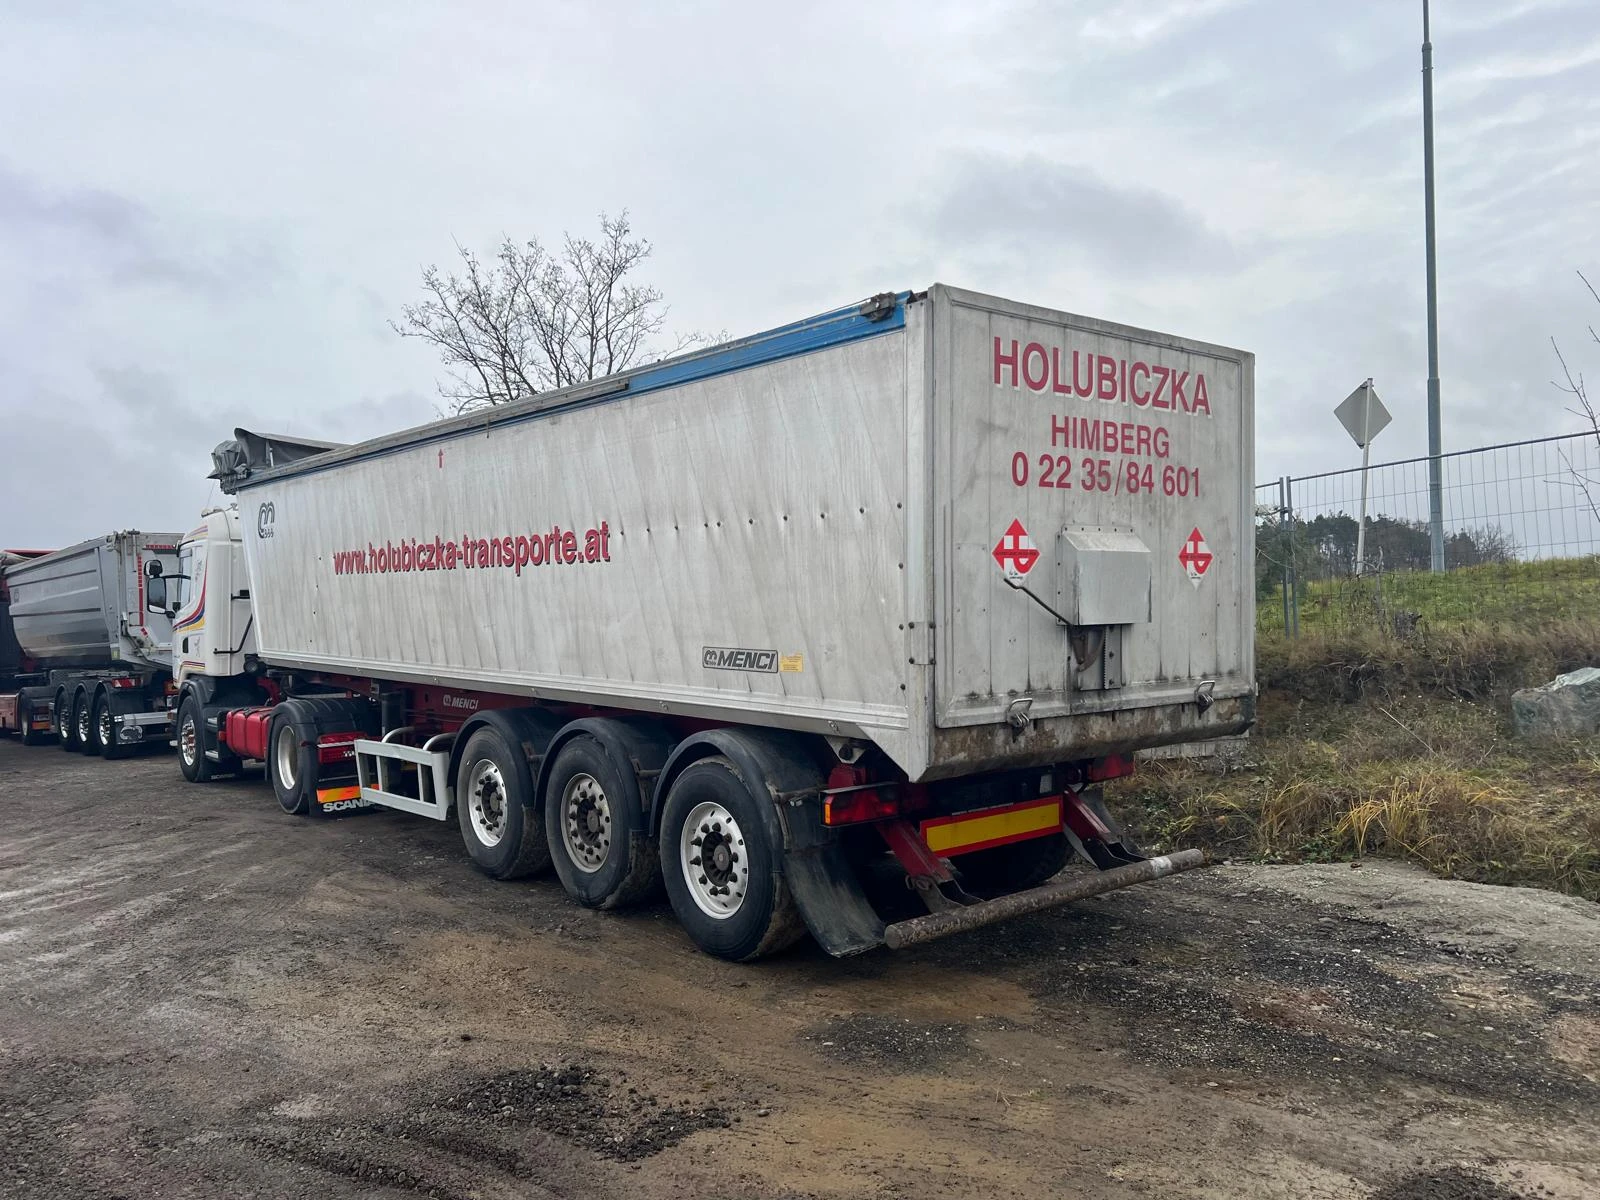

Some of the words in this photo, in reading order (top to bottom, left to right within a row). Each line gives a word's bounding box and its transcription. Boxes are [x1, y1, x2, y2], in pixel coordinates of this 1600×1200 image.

[993, 336, 1211, 417] HOLUBICZKA
[1051, 414, 1169, 458] HIMBERG
[1011, 451, 1029, 487] 0
[1038, 454, 1072, 489] 22
[1081, 457, 1155, 497] 35/84
[1162, 465, 1200, 497] 601
[333, 521, 611, 577] www.holubiczka-transporte.at
[717, 650, 776, 670] MENCI
[451, 697, 479, 710] MENCI
